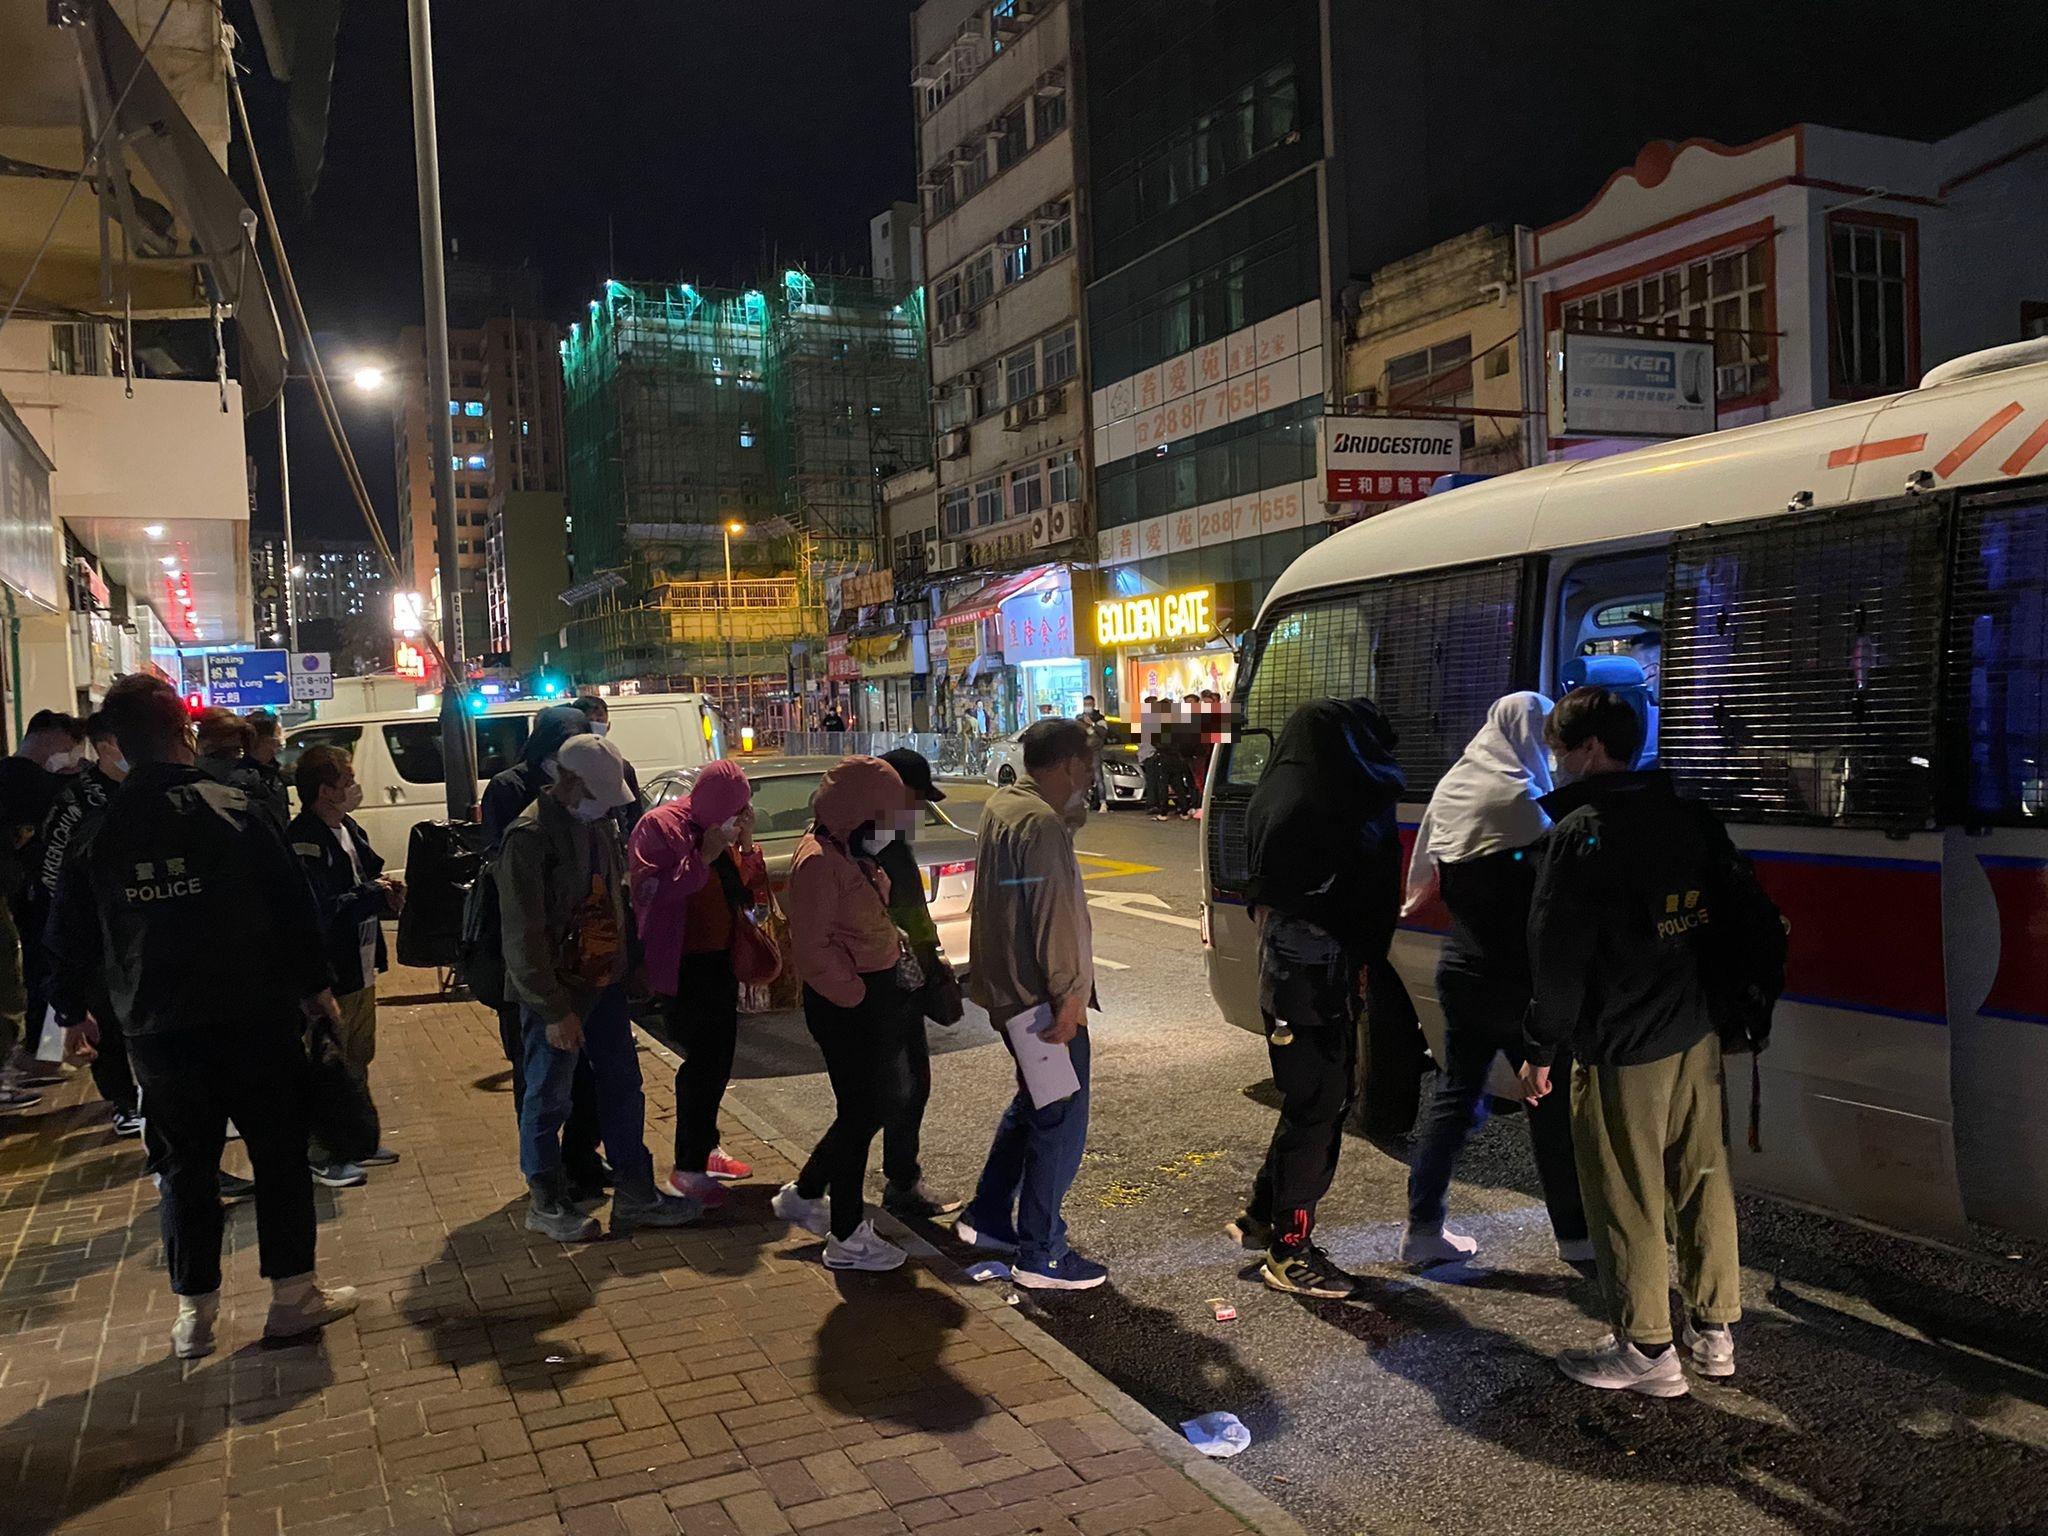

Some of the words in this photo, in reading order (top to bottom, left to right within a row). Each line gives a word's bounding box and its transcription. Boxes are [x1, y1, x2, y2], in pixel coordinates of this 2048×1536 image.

[1153, 399, 1206, 440] 2887
[1215, 375, 1271, 417] 7655
[1334, 433, 1453, 455] BRIDGESTONE
[1201, 506, 1243, 536] 2887
[1250, 495, 1297, 526] 7655
[1097, 597, 1161, 645] GOLDEN
[1164, 590, 1210, 637] GATE
[209, 655, 244, 665] Fanling
[212, 681, 237, 690] Yuen
[240, 680, 263, 689] Long
[213, 692, 240, 703] 元朗
[125, 878, 202, 902] POLICE
[1657, 908, 1709, 938] POLICE
